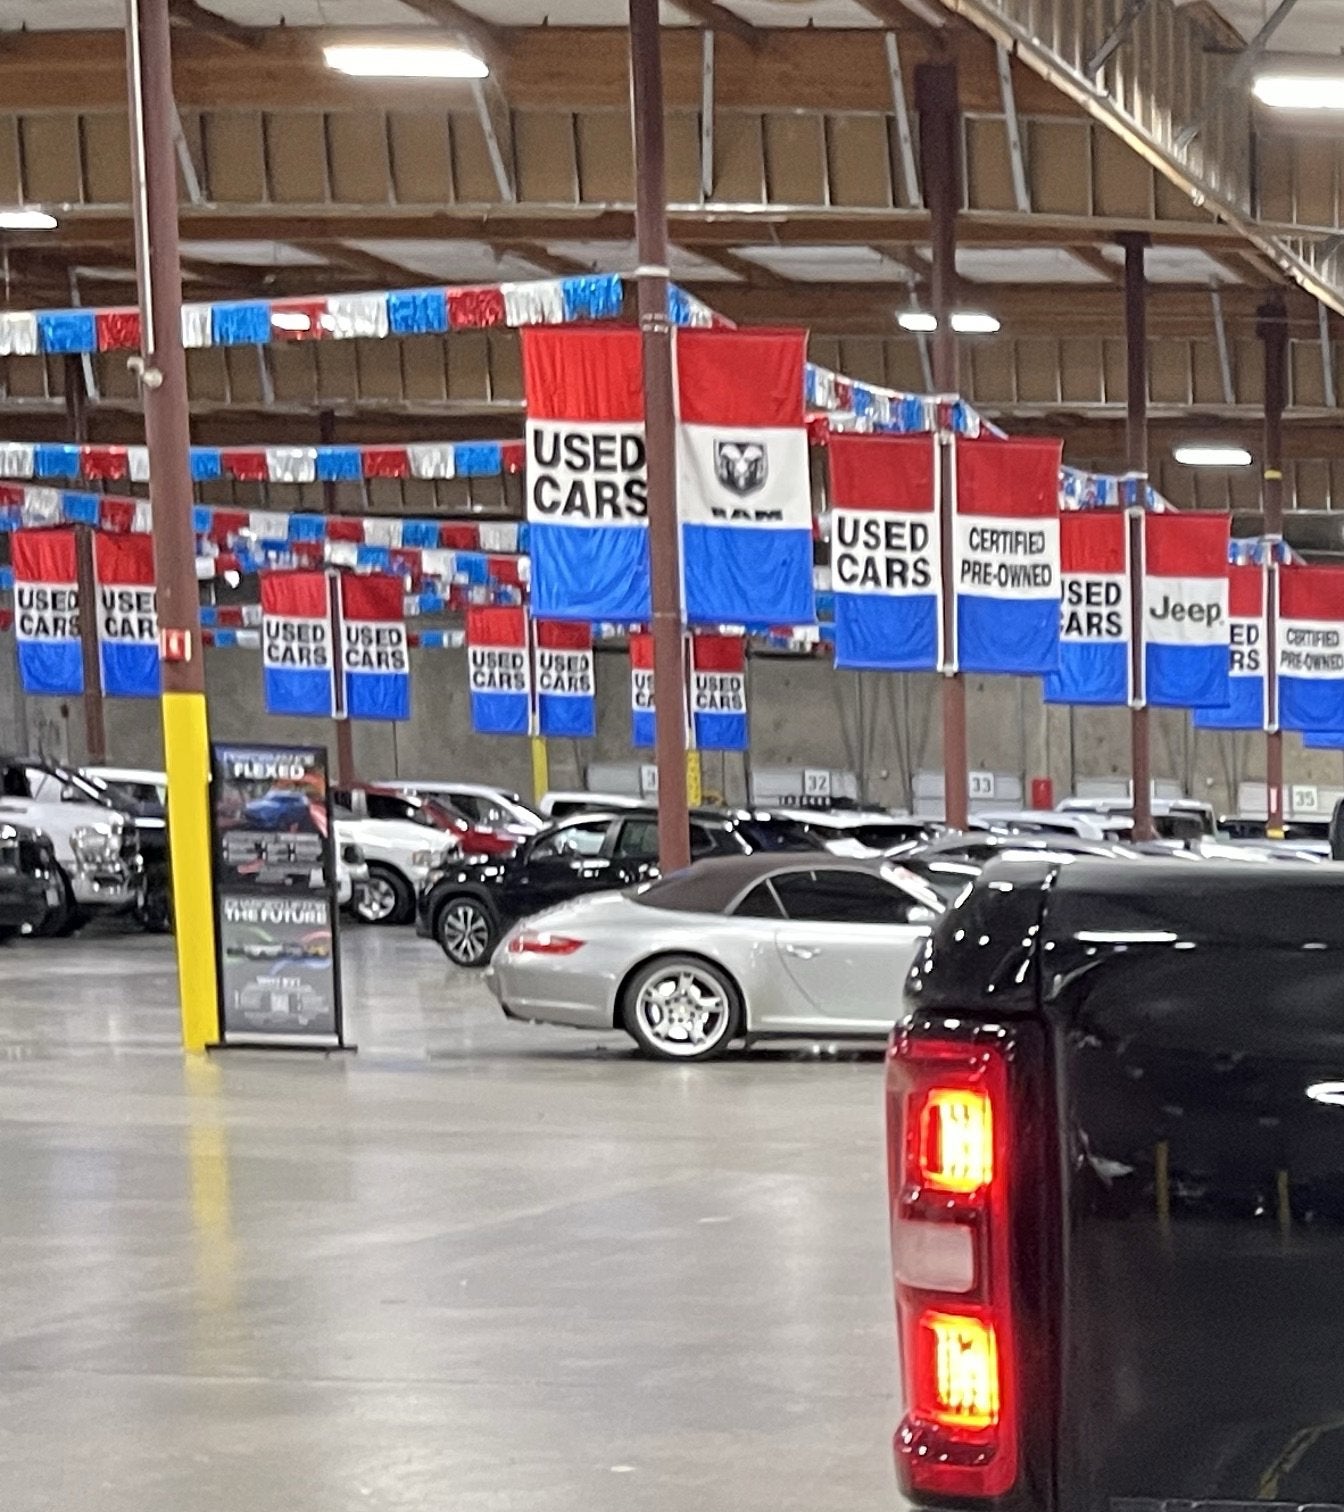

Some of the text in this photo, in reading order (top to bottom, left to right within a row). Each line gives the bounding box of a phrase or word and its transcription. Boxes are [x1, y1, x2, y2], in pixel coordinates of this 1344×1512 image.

[534, 429, 645, 473] USED
[533, 475, 647, 519] CARS
[711, 507, 783, 521] RAM
[837, 516, 930, 553] USED
[968, 527, 1046, 555] CERTIFIED
[837, 553, 932, 588] CARS
[960, 559, 1052, 588] PRE-OWNED
[18, 588, 78, 611] USED
[103, 589, 157, 614] USE
[1150, 595, 1222, 628] Jeep
[105, 615, 156, 639] CAR
[266, 621, 325, 644] USED
[1061, 611, 1123, 638] ARS
[346, 625, 402, 647] USED
[1286, 627, 1340, 647] CERTIFIED
[267, 643, 327, 666] CARS
[346, 649, 405, 670] CARS
[472, 650, 524, 671] USED
[540, 653, 590, 673] USED
[1279, 650, 1344, 671] PRE-OWNED
[472, 671, 526, 690] CARS
[540, 673, 591, 692] CARS
[696, 675, 742, 692] USED
[696, 693, 743, 710] CARS
[807, 776, 828, 791] 32
[971, 776, 992, 793] 33
